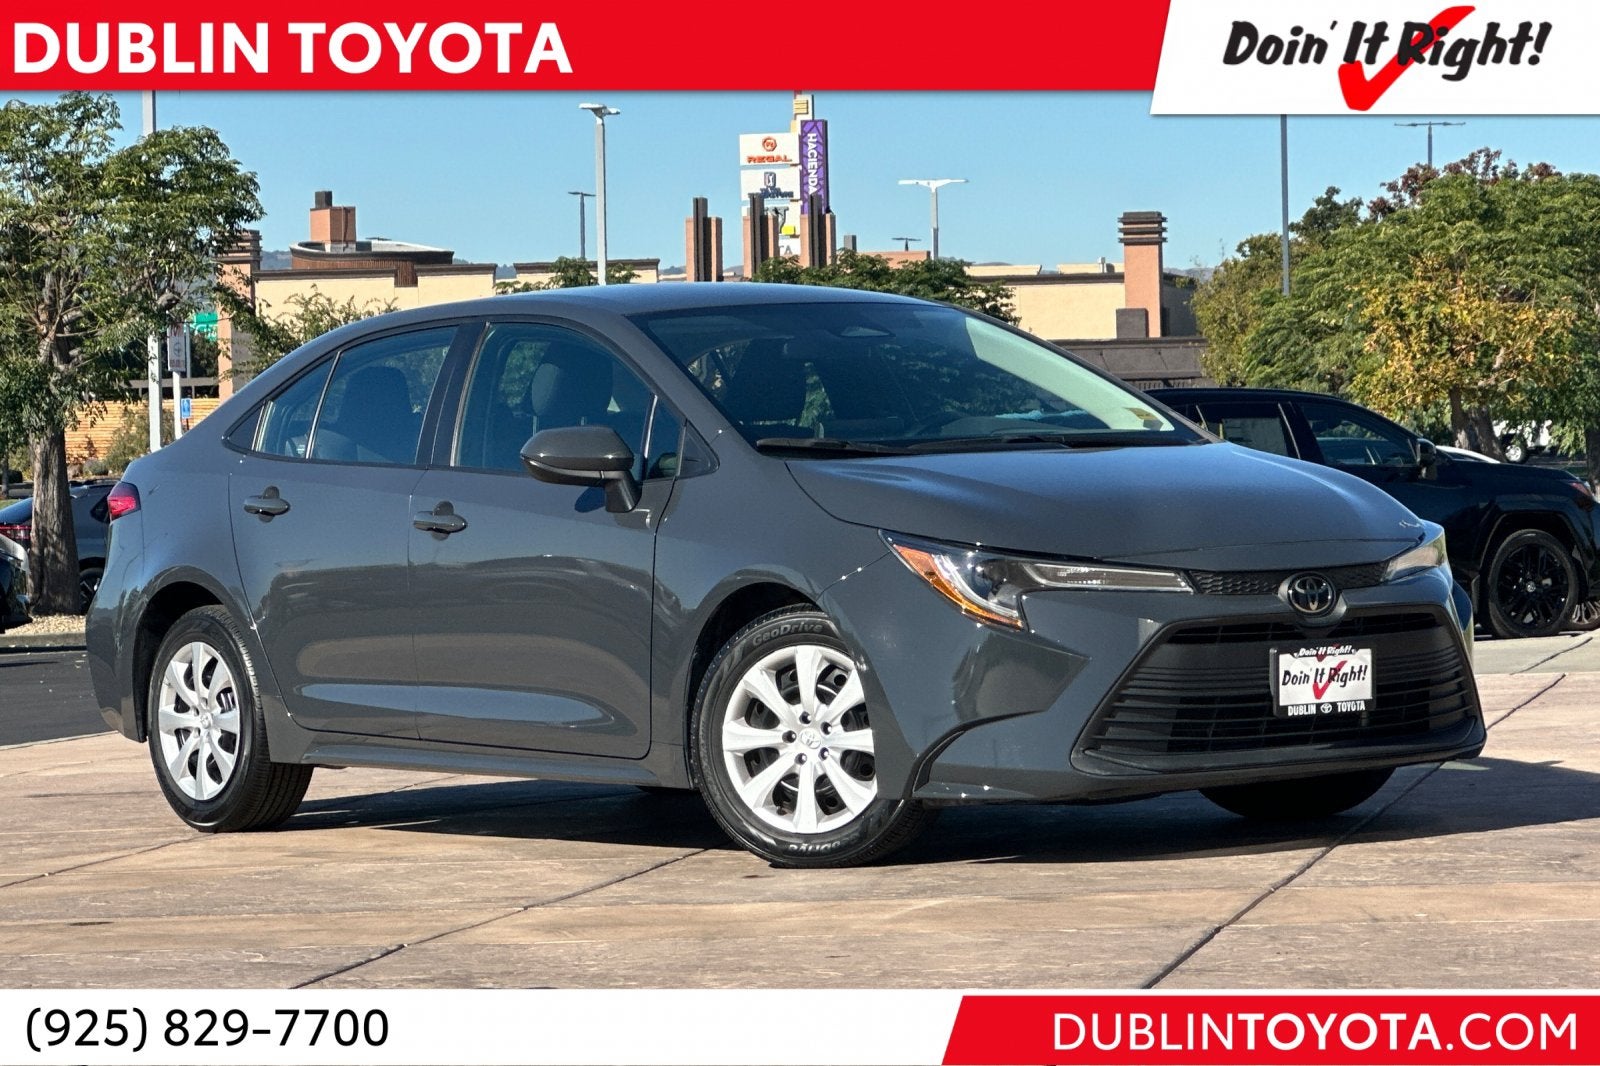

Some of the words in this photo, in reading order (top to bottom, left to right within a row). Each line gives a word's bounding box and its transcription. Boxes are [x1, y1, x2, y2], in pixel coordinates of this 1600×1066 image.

[746, 154, 793, 164] REGAL
[806, 133, 819, 196] HACIENDA
[1319, 647, 1327, 655] It
[1327, 645, 1353, 657] Right!
[1282, 667, 1312, 686] Doin'
[1314, 667, 1326, 684] It
[1327, 664, 1368, 688] Right!
[1287, 704, 1317, 716] DUBLIN
[1336, 700, 1366, 713] TOYOTA
